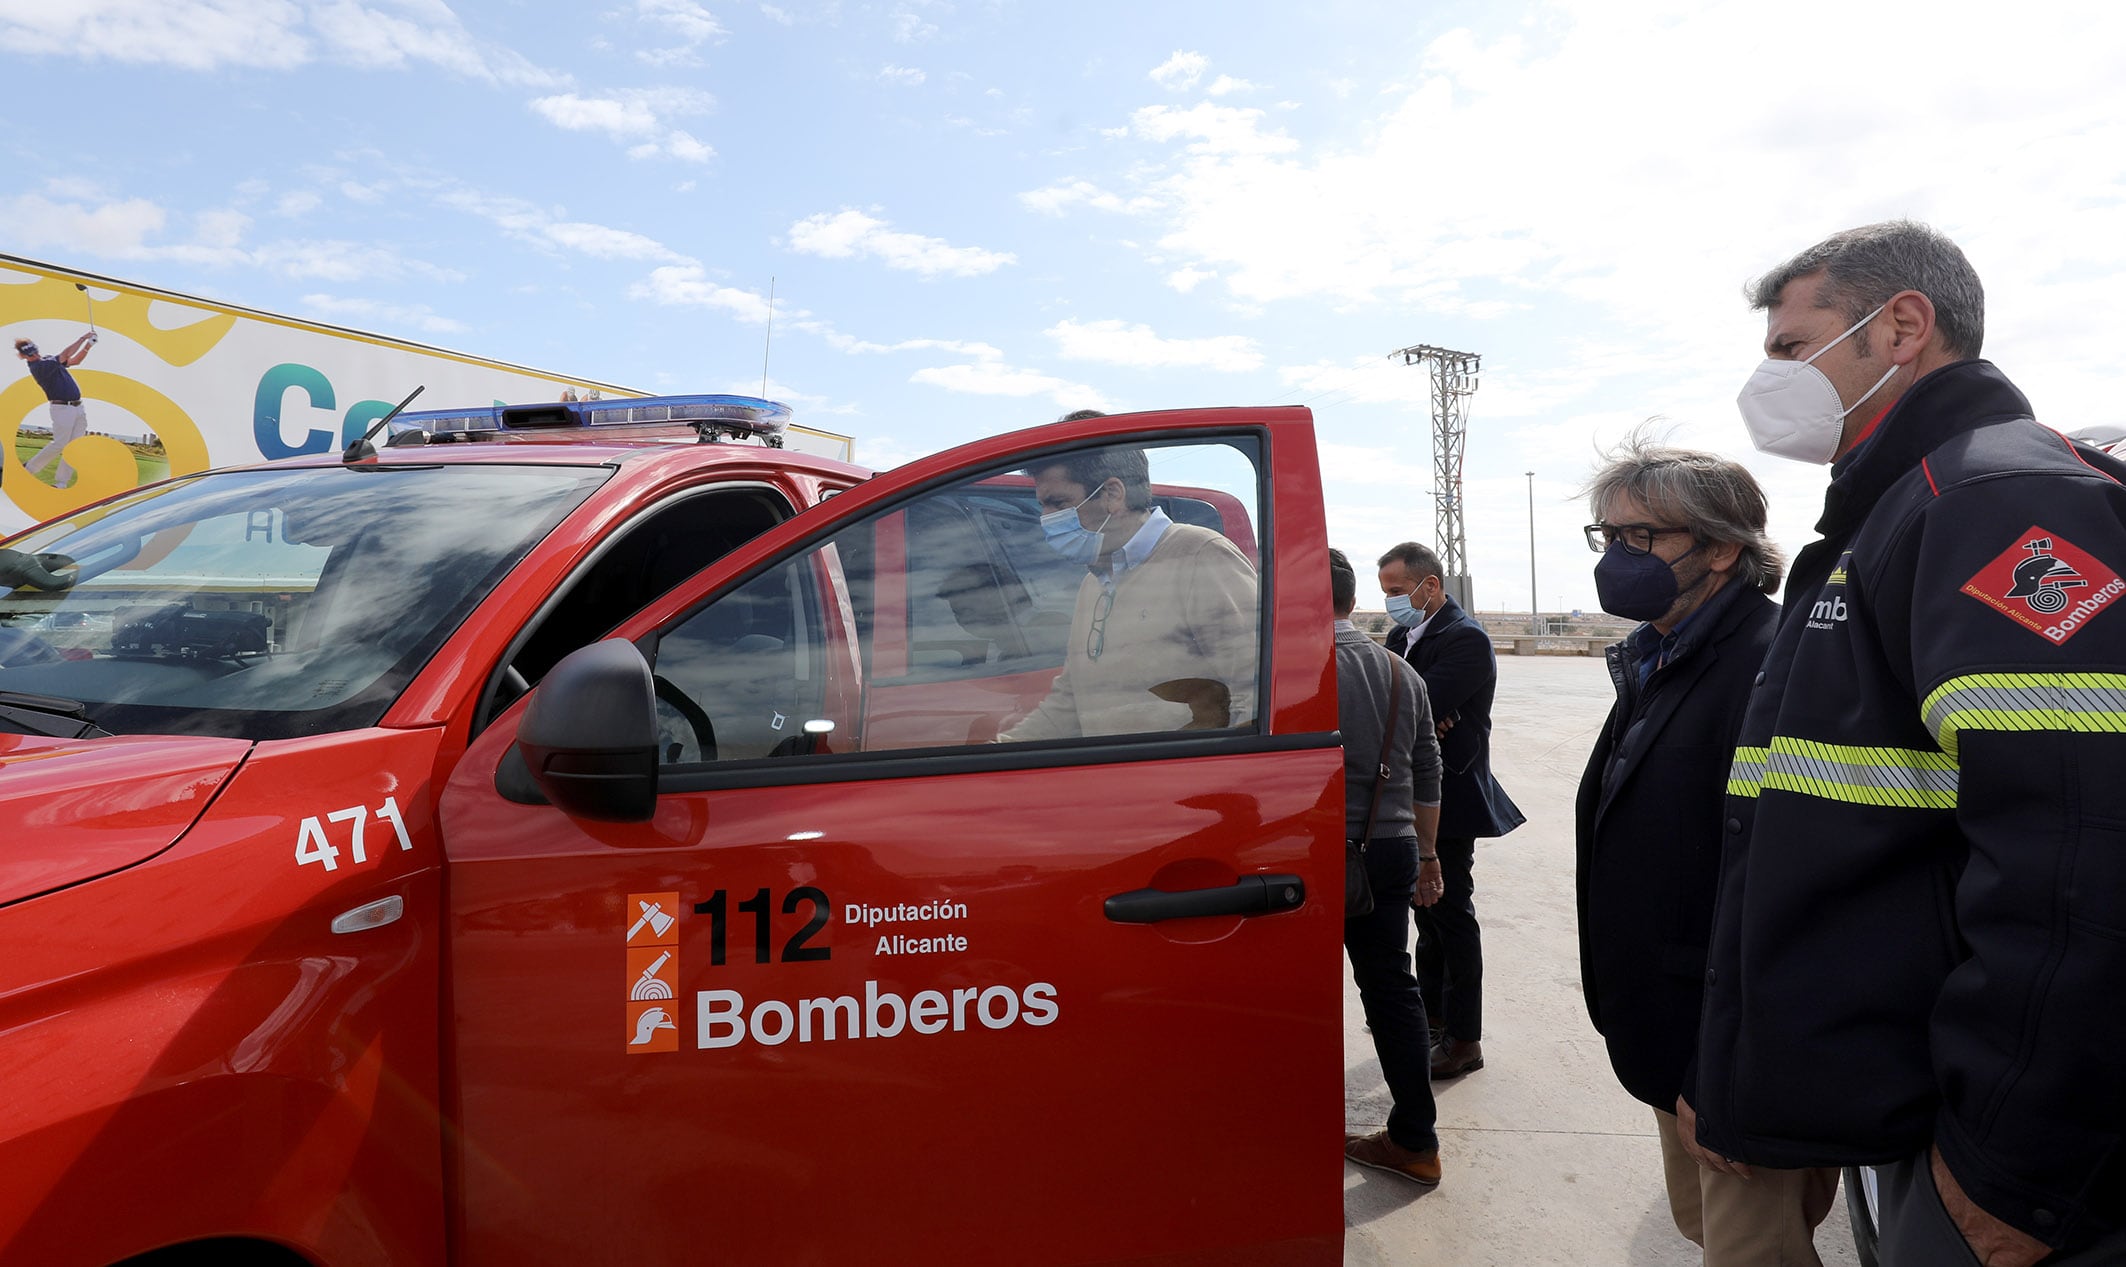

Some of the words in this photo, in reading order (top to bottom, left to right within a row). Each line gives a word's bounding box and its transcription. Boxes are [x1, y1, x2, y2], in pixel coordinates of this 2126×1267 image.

[1965, 583, 2008, 611] Diputación
[2007, 607, 2043, 631] Alicante
[2043, 577, 2126, 642] Bomberos
[294, 795, 413, 872] 471
[693, 886, 832, 967] 112
[844, 898, 968, 928] Diputación
[874, 932, 968, 957] Alicante
[696, 979, 1060, 1050] Bomberos
